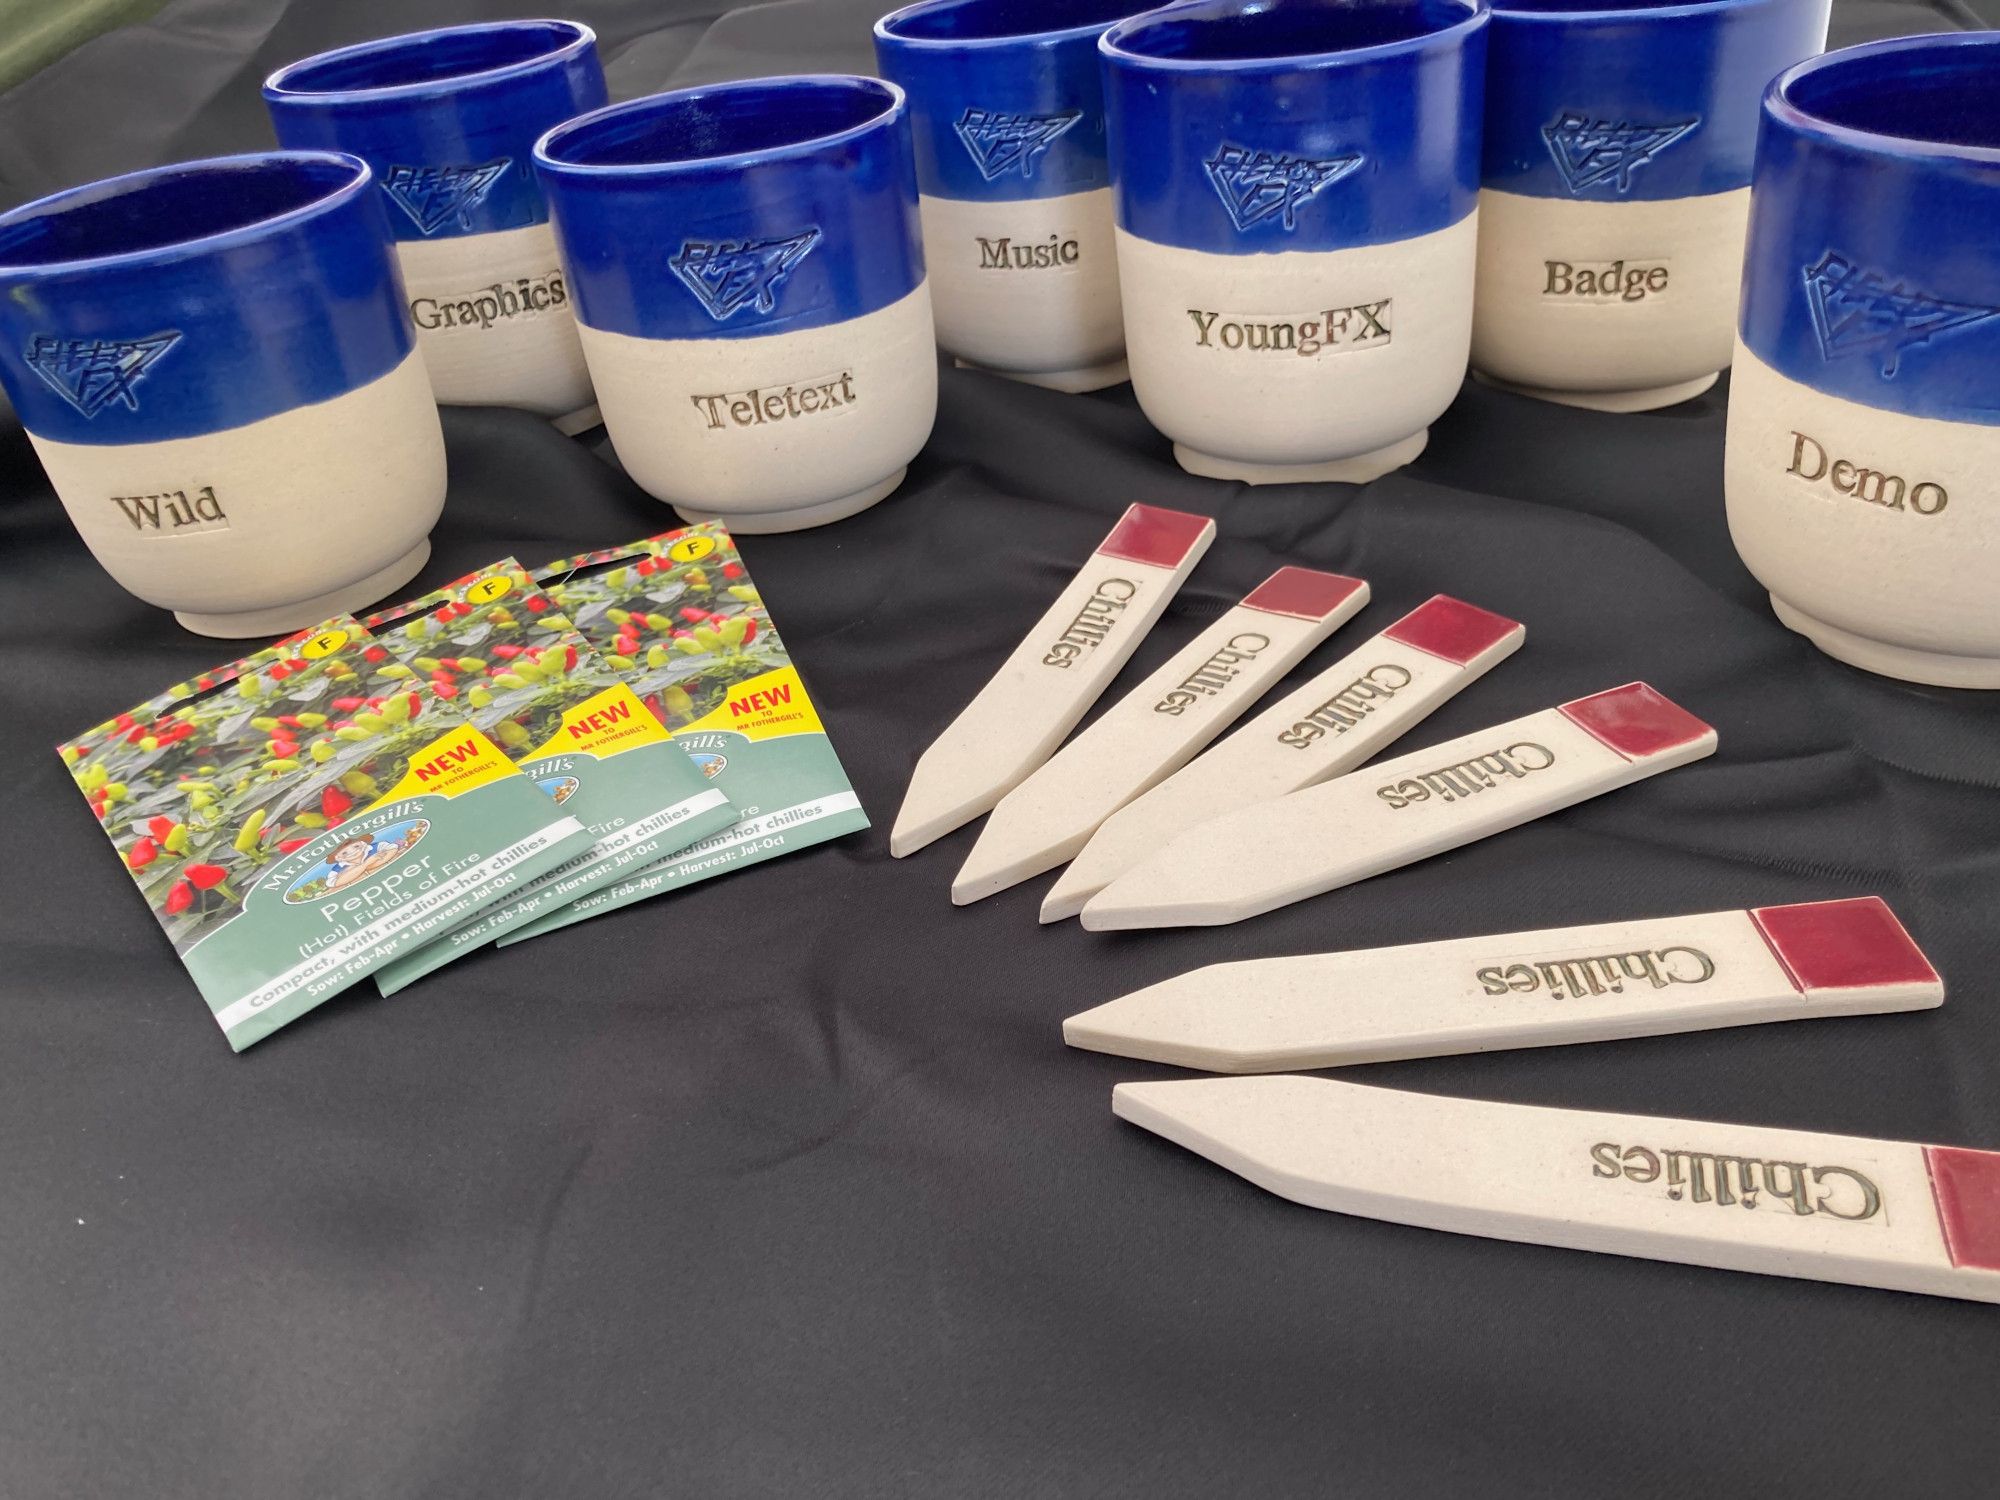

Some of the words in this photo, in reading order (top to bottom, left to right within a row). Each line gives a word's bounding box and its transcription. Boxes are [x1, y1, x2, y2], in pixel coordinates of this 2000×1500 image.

[975, 234, 1079, 269] Music
[410, 279, 566, 329] Graphics
[1542, 260, 1668, 302] Badge
[1187, 300, 1391, 357] YoungFX
[690, 372, 857, 429] Teletext
[1786, 431, 1948, 515] Demo
[110, 486, 226, 530] Wild
[1042, 578, 1136, 668] Chillies
[729, 683, 791, 718] NEW
[1154, 633, 1270, 716] Chillies
[567, 700, 631, 739] NEW
[603, 727, 615, 735] TO
[761, 710, 773, 718] TO
[1278, 664, 1411, 750] Chillies
[415, 739, 479, 782] NEW
[452, 767, 464, 775] TO
[1377, 742, 1555, 810] Chillies
[635, 806, 690, 837] chillies
[766, 805, 823, 829] chillies
[319, 855, 432, 923] Pepper
[451, 923, 487, 946] Sow:
[487, 896, 541, 927] Feb-Apr
[554, 861, 612, 895] Harvest:
[614, 840, 659, 867] Jul-Oct
[572, 894, 608, 912] Sow:
[610, 875, 663, 899] Feb-Apr
[679, 850, 737, 877] Harvest:
[740, 835, 785, 858] Jul-Oct
[250, 957, 336, 1008] Compact,
[339, 930, 381, 956] with
[384, 868, 488, 931] medium-hot
[491, 836, 548, 870] chillies
[299, 924, 349, 959] (Hot)
[353, 887, 413, 926] Fields
[419, 872, 438, 890] of
[441, 852, 481, 876] Fire
[306, 971, 345, 997] Sow:
[345, 938, 398, 975] Feb-Apr
[412, 898, 471, 936] Harvest:
[471, 872, 517, 901] Jul-Oct
[1476, 946, 1716, 1000] Chillies
[1590, 1142, 1881, 1220] Chillies
